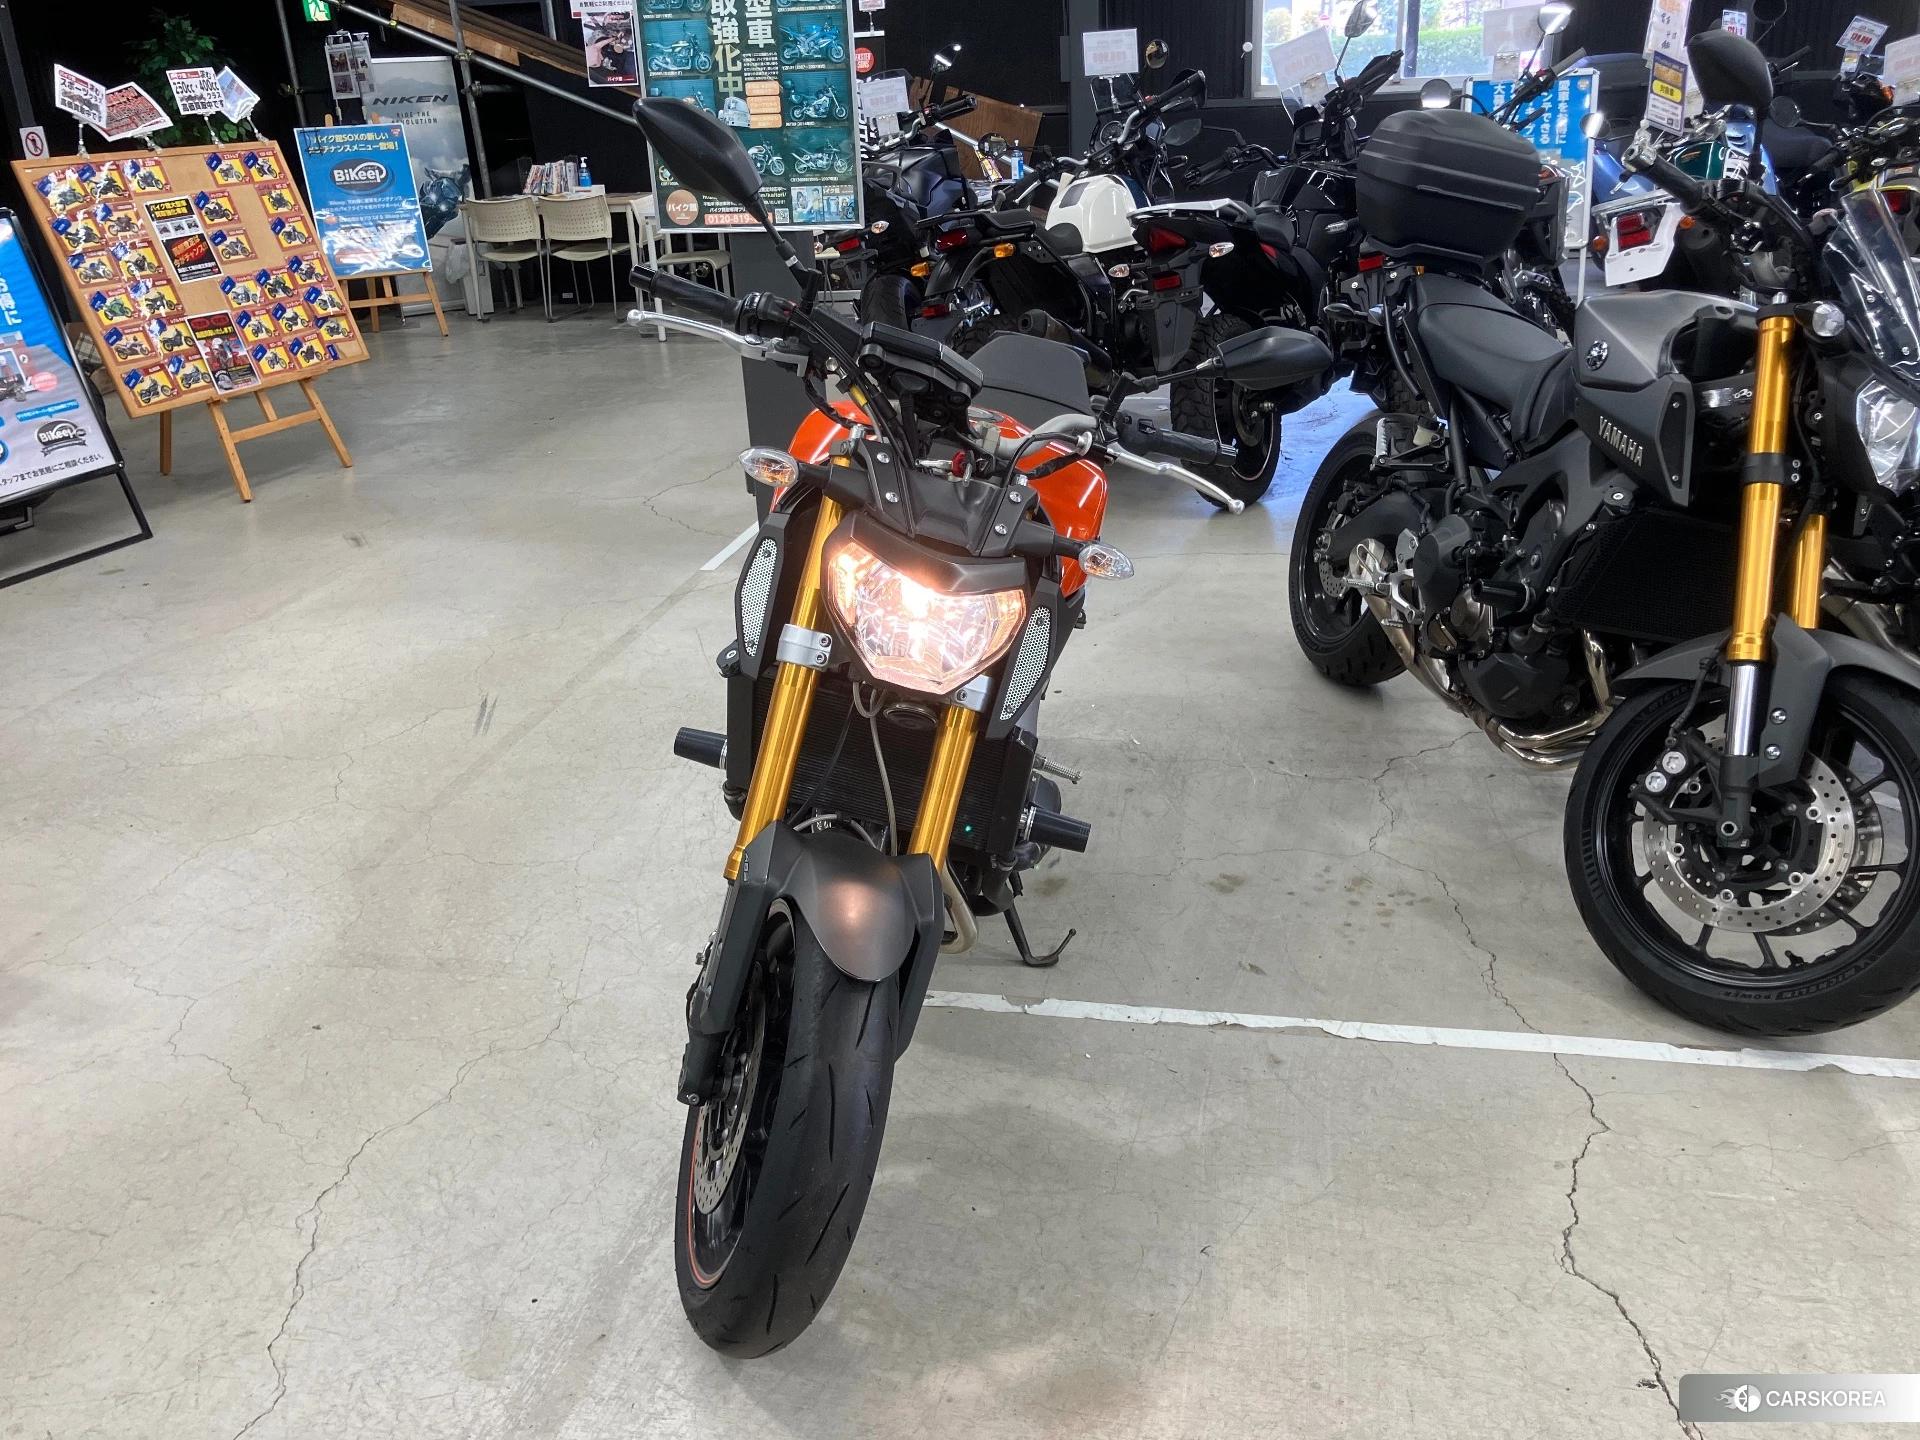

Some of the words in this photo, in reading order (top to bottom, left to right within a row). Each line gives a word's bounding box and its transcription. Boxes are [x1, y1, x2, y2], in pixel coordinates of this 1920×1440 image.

[206, 92, 222, 100] クラス
[372, 94, 449, 106] NIKEN
[1539, 92, 1553, 144] ンテできる
[1599, 415, 1643, 466] YAMAHA
[0, 453, 104, 487] タッフまでお気軽にご相談ください。
